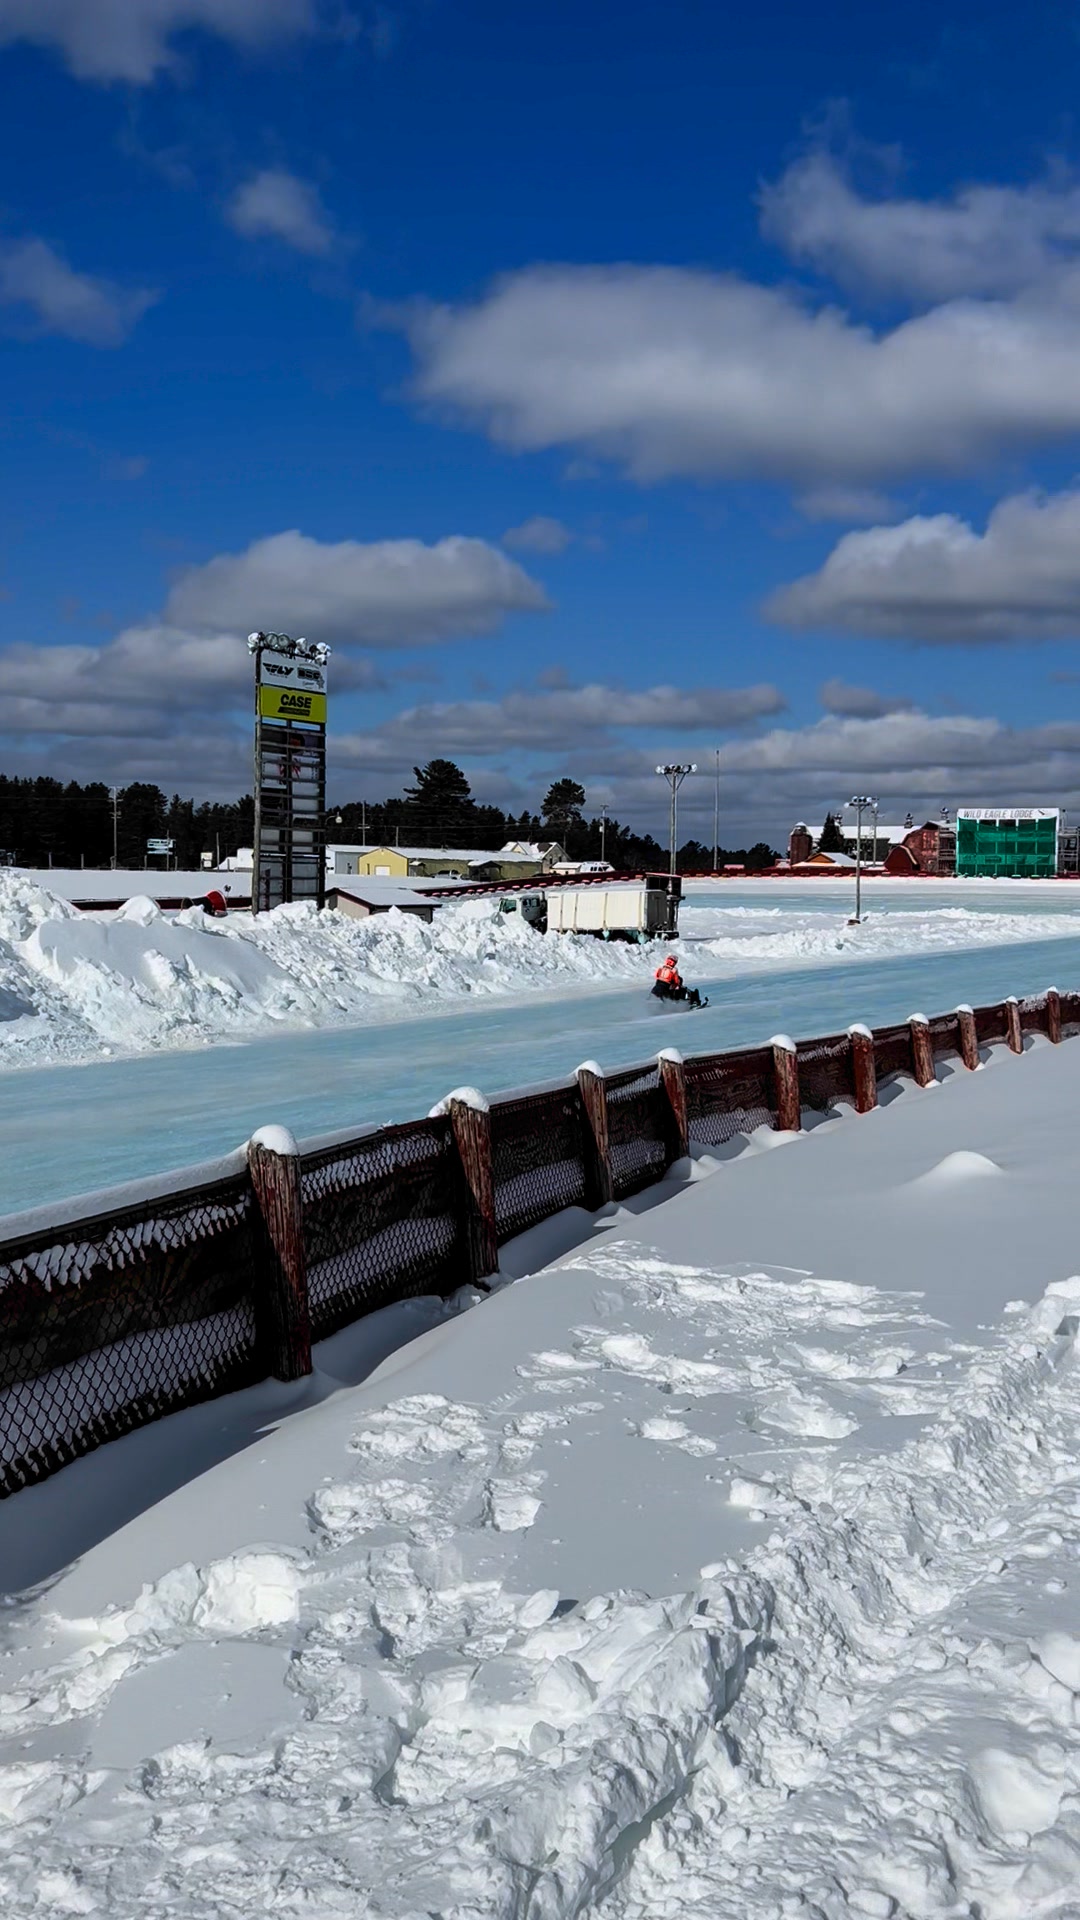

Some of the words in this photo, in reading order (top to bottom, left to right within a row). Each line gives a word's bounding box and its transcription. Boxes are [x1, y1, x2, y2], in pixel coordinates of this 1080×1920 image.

[262, 662, 294, 676] FLY
[280, 694, 312, 708] CASE
[963, 810, 981, 818] WILD
[984, 810, 1007, 818] EAGLE
[1010, 810, 1034, 818] LODGE
